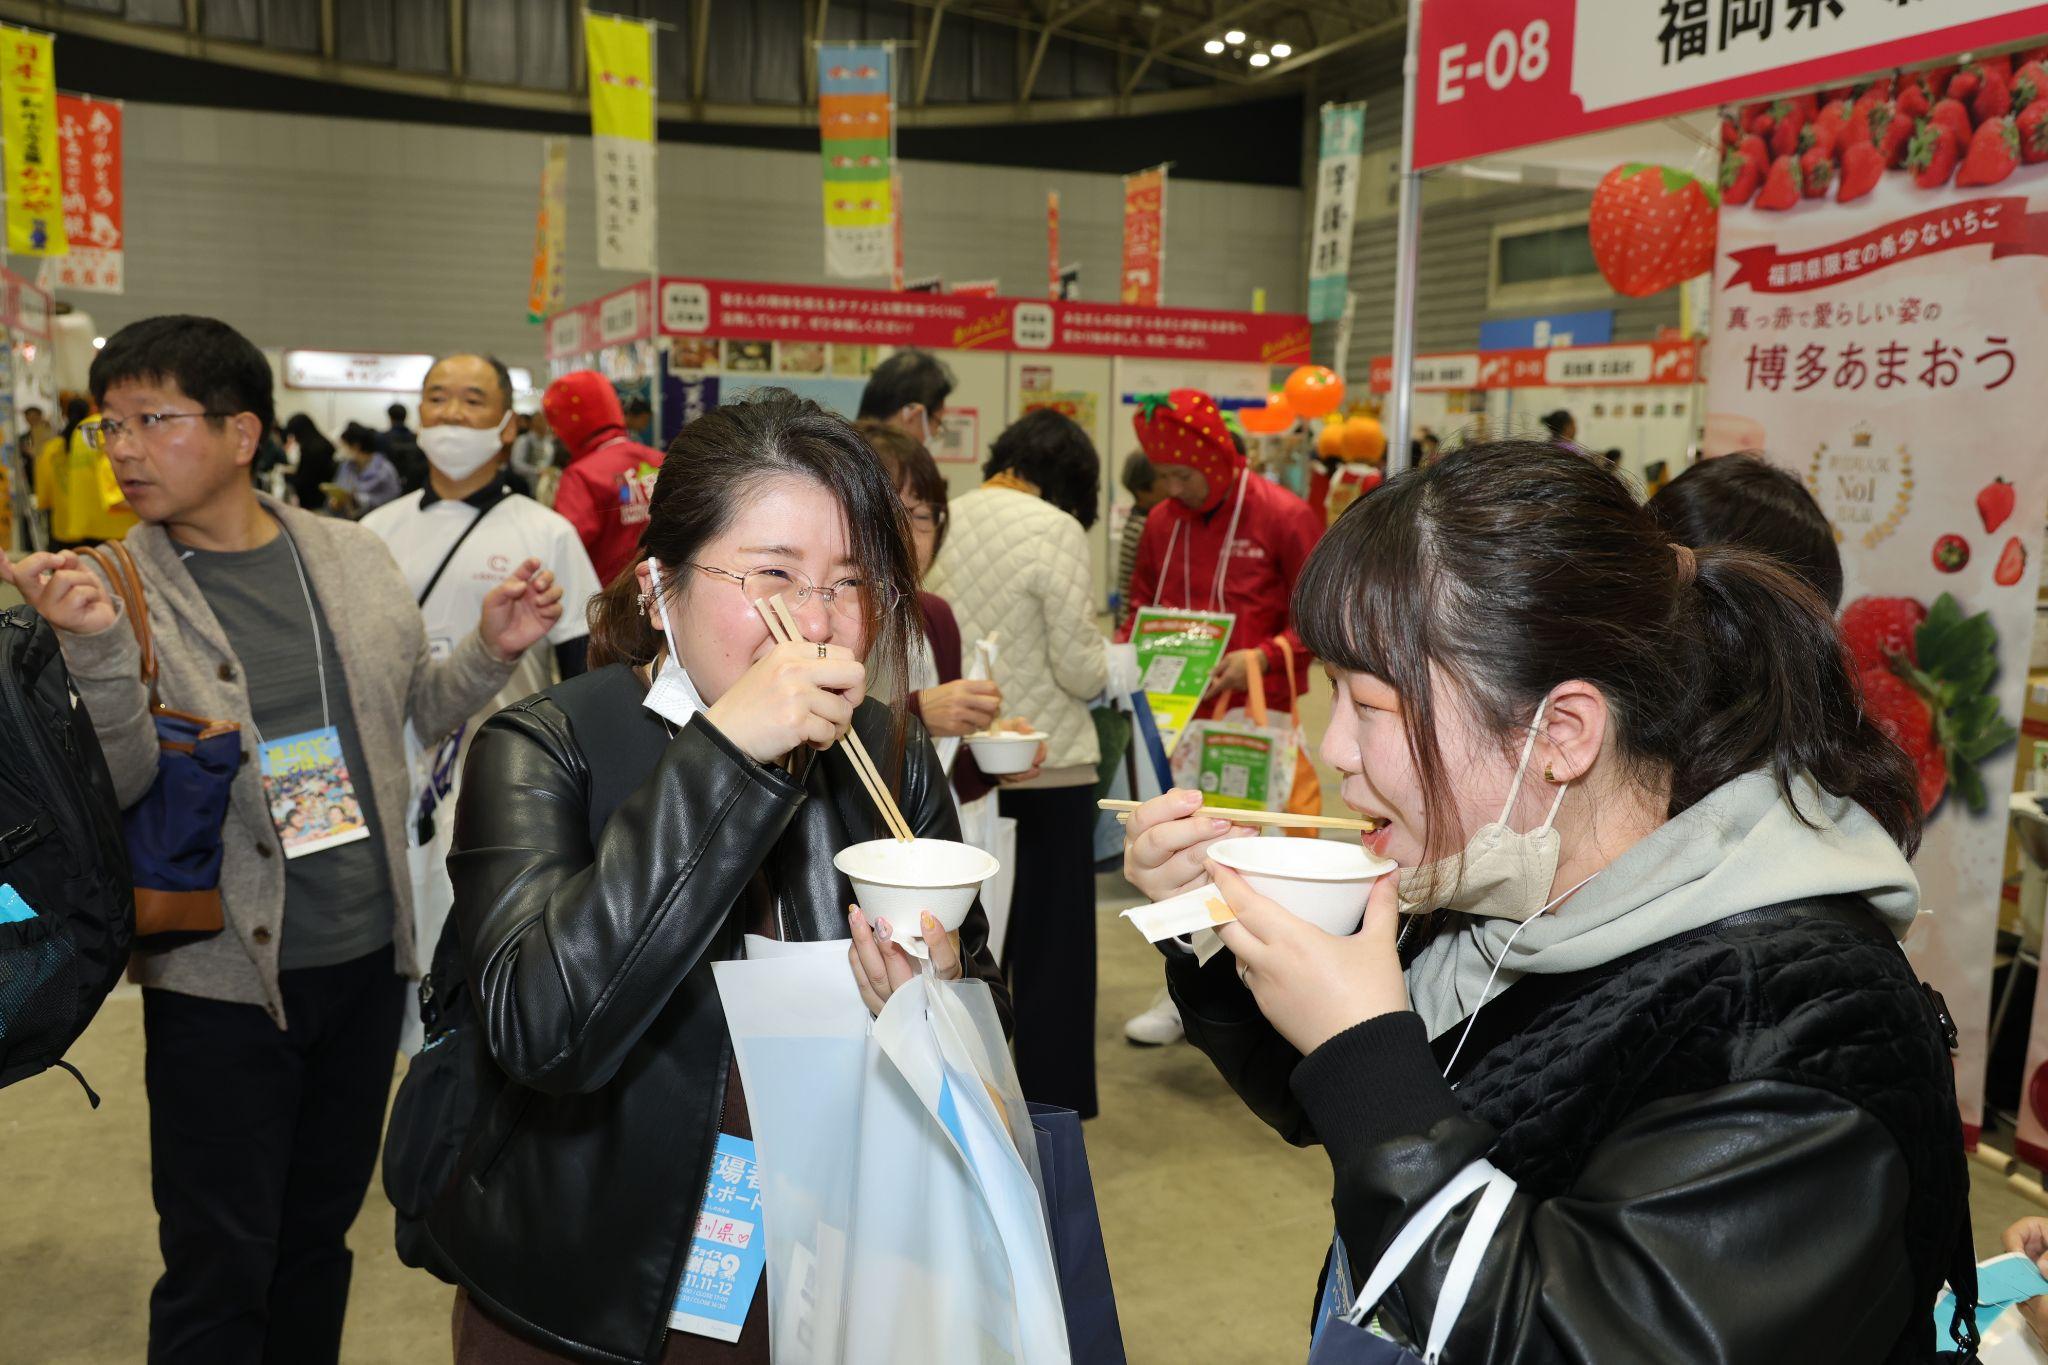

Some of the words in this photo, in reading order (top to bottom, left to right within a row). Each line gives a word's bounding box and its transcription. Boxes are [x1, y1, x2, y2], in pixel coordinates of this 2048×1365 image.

[1437, 18, 1550, 105] E-08
[1767, 203, 2003, 288] 福岡県限定の希少ないちご
[1727, 298, 1943, 331] 真っ赤で愛らしい姿の
[1745, 336, 2017, 391] 博多あまおう
